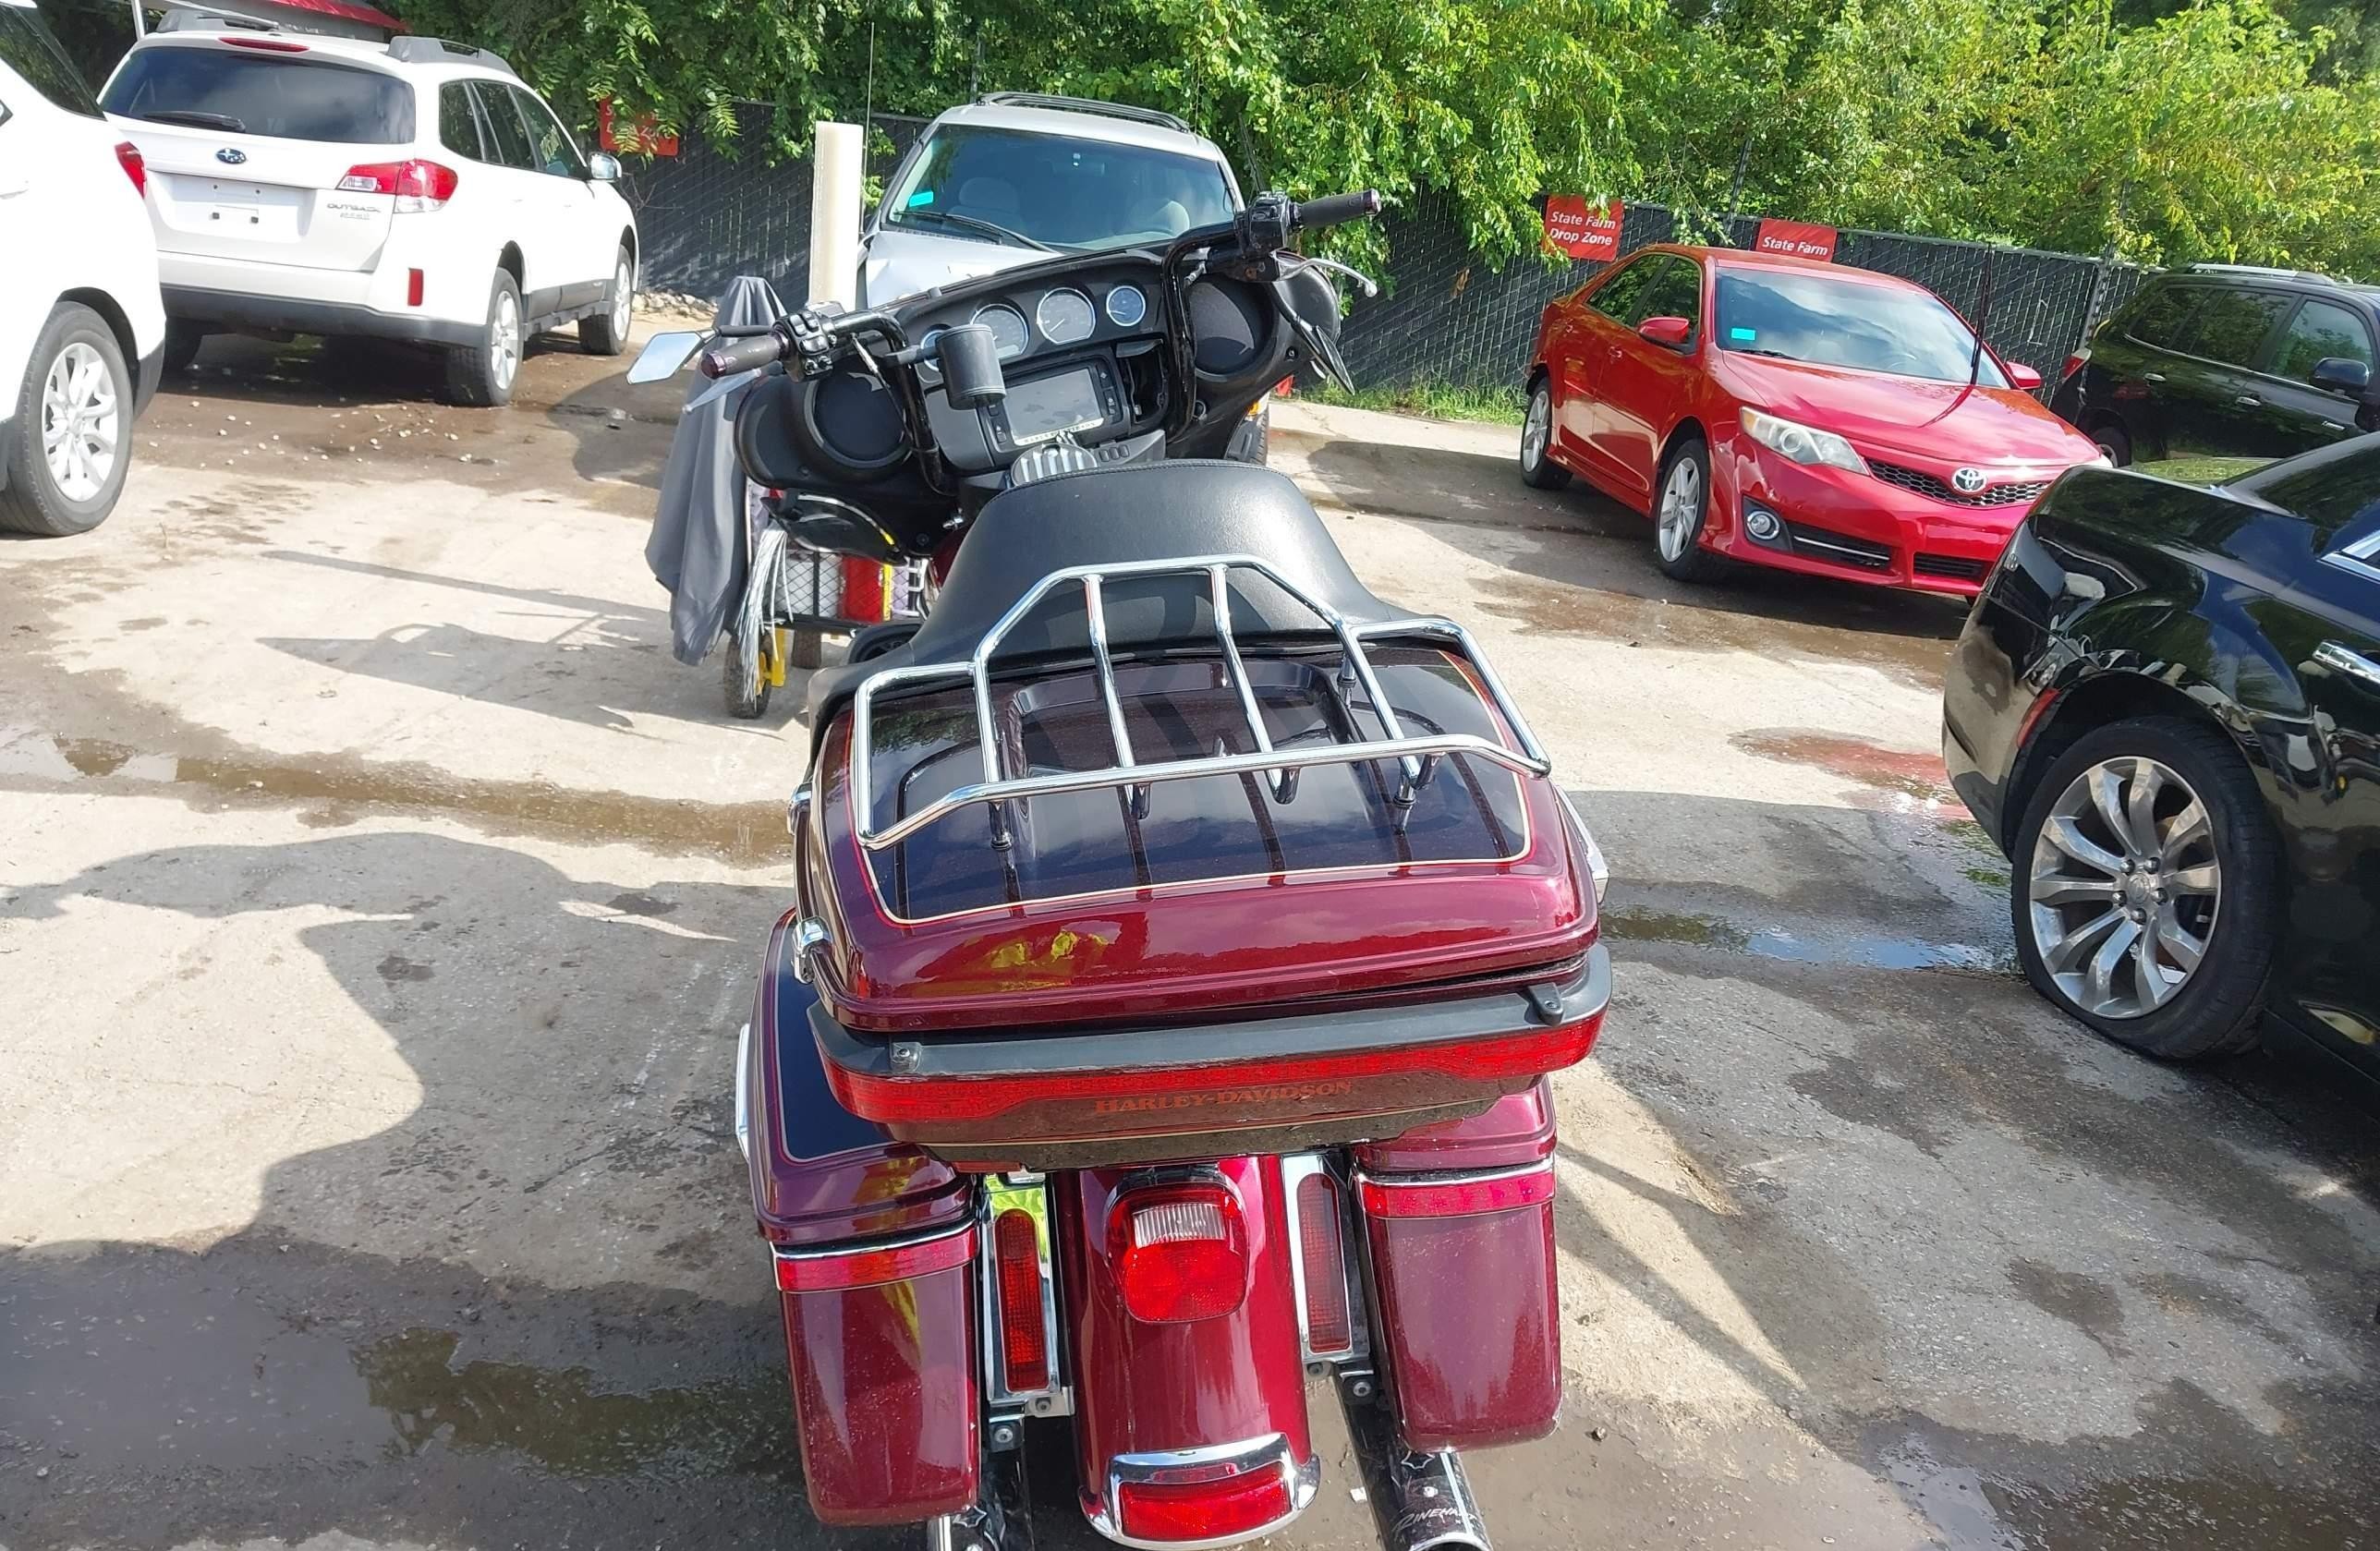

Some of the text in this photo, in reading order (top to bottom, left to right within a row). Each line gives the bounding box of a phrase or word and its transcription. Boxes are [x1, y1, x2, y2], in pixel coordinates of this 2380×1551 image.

[1550, 212, 1616, 230] State Farm
[1549, 227, 1613, 246] Drop Zone
[1762, 236, 1828, 256] State Farm
[1095, 1080, 1354, 1114] HARLEY-DAVIDSON
